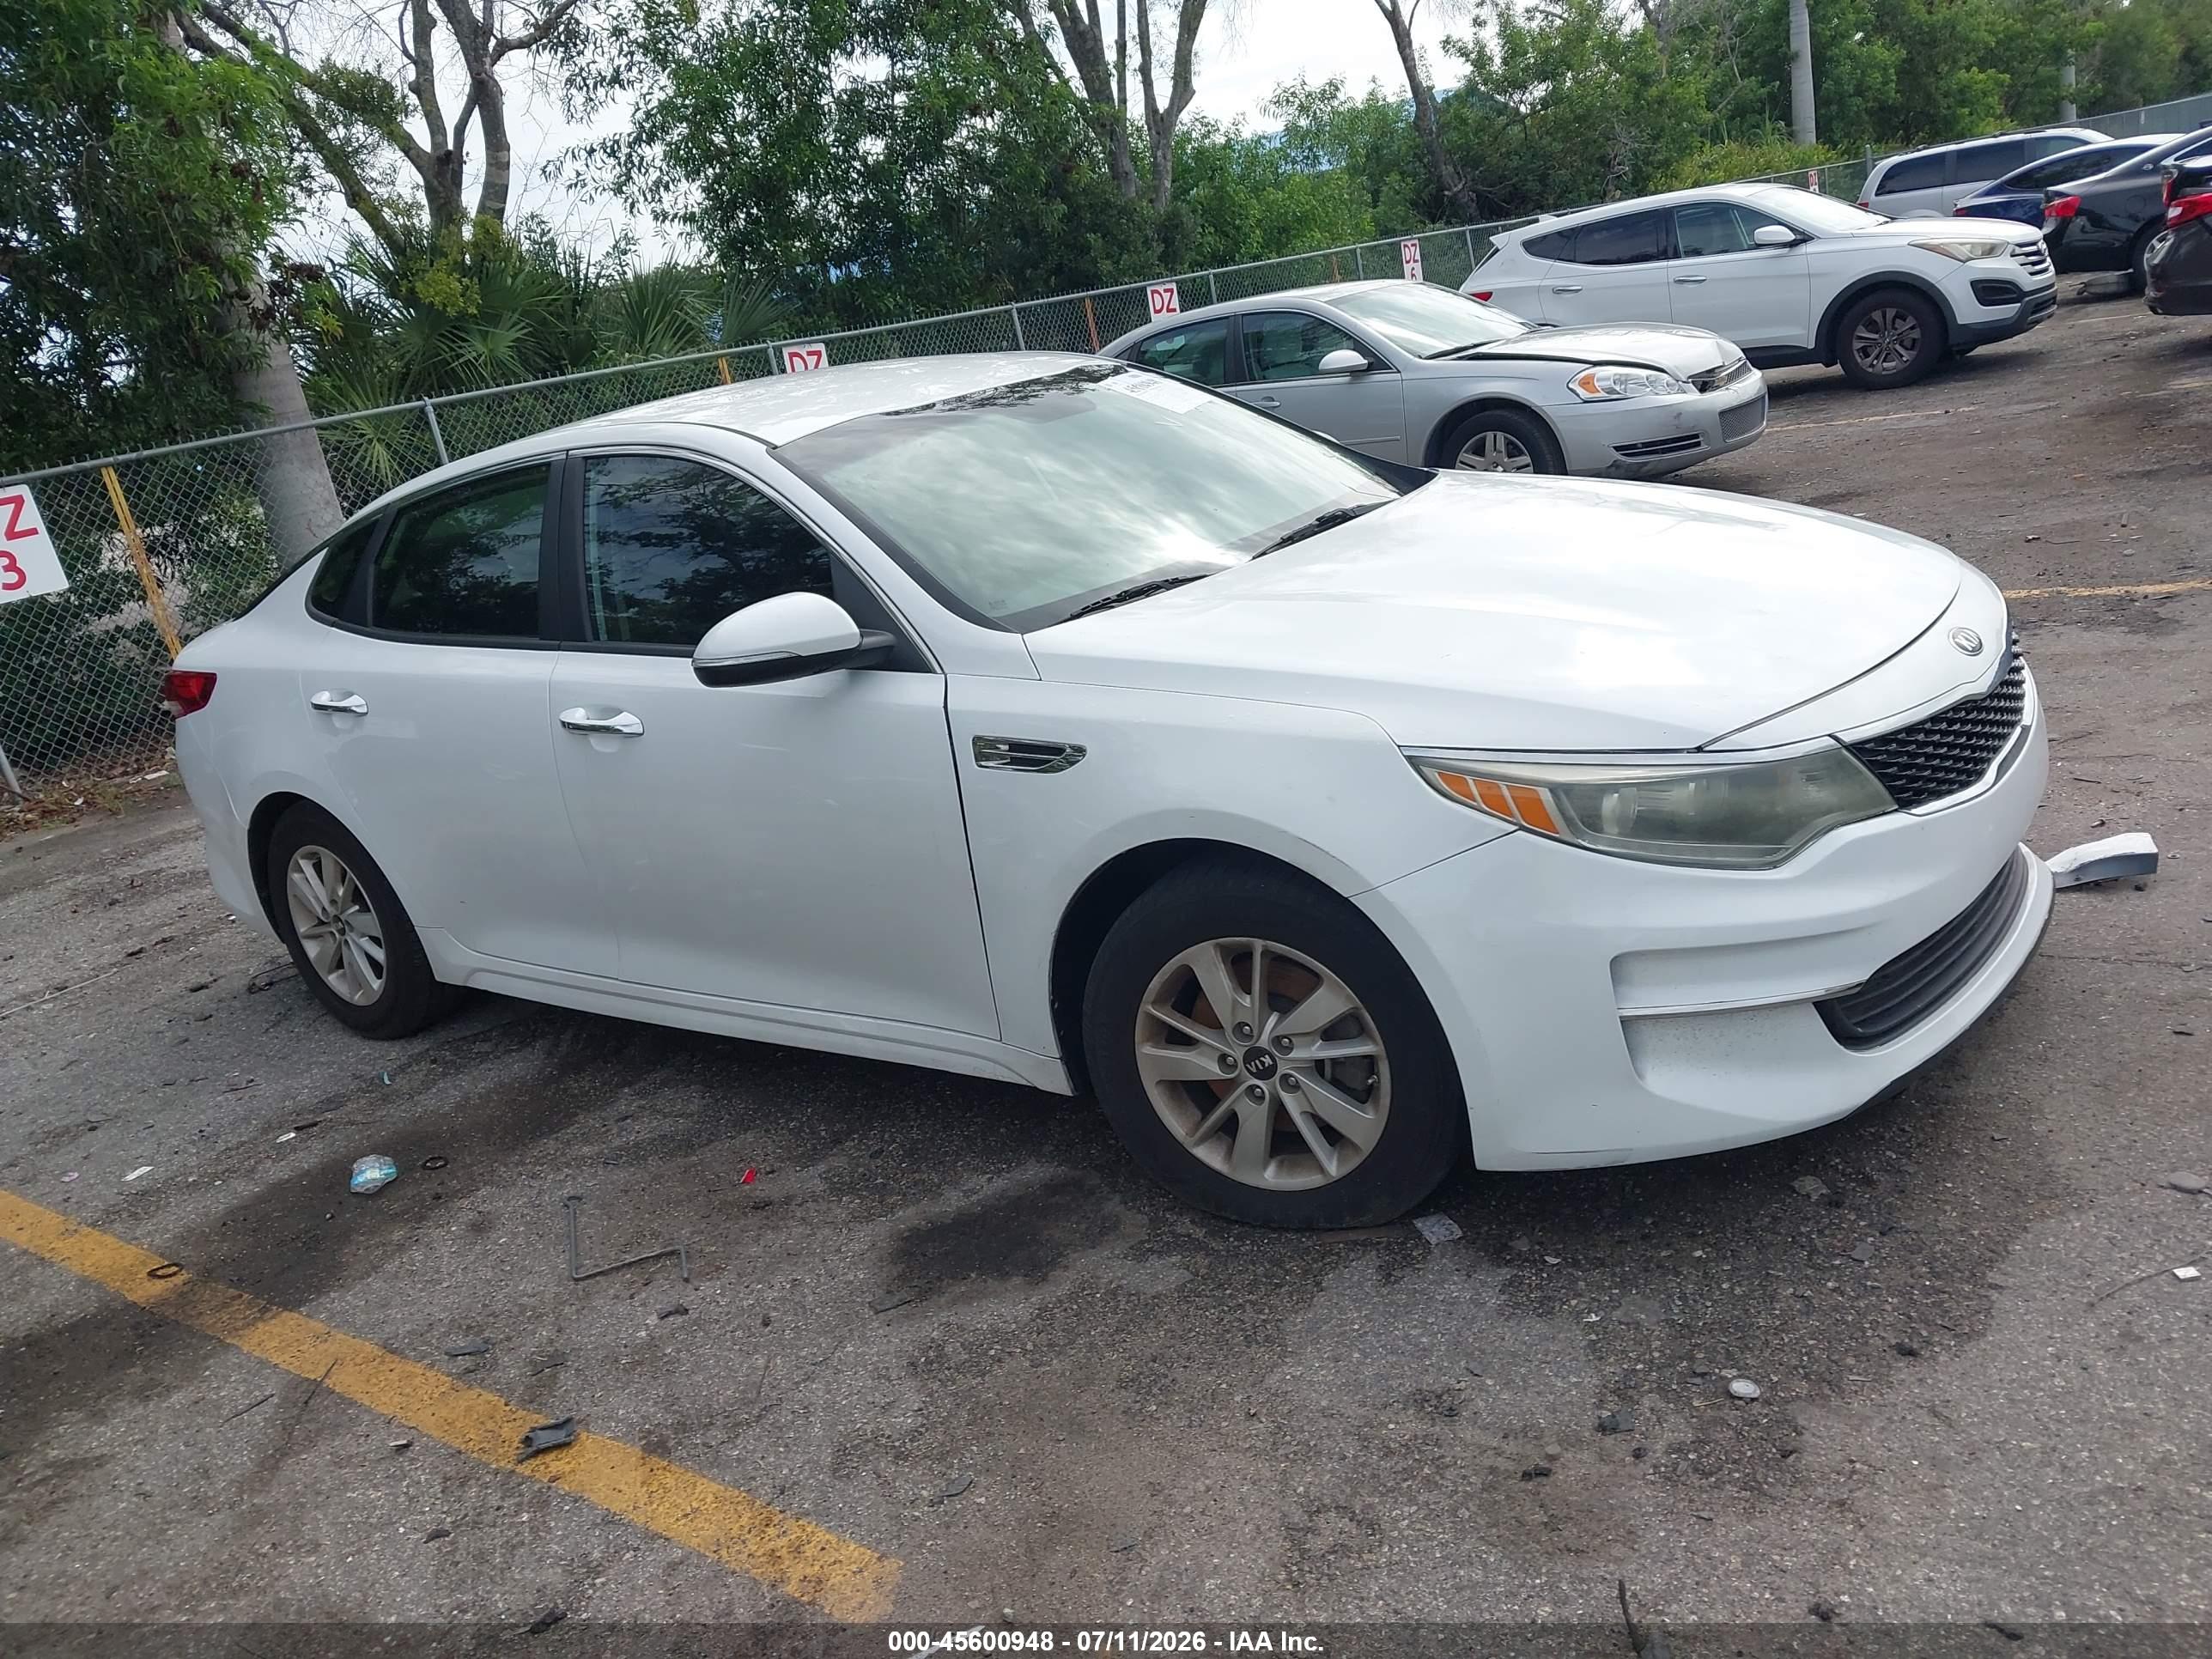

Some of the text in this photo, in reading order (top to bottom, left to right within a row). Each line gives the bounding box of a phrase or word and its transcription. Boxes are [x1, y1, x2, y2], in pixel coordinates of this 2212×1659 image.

[1403, 243, 1419, 264] DZ
[1151, 288, 1177, 314] DZ
[1245, 1054, 1273, 1073] KIA
